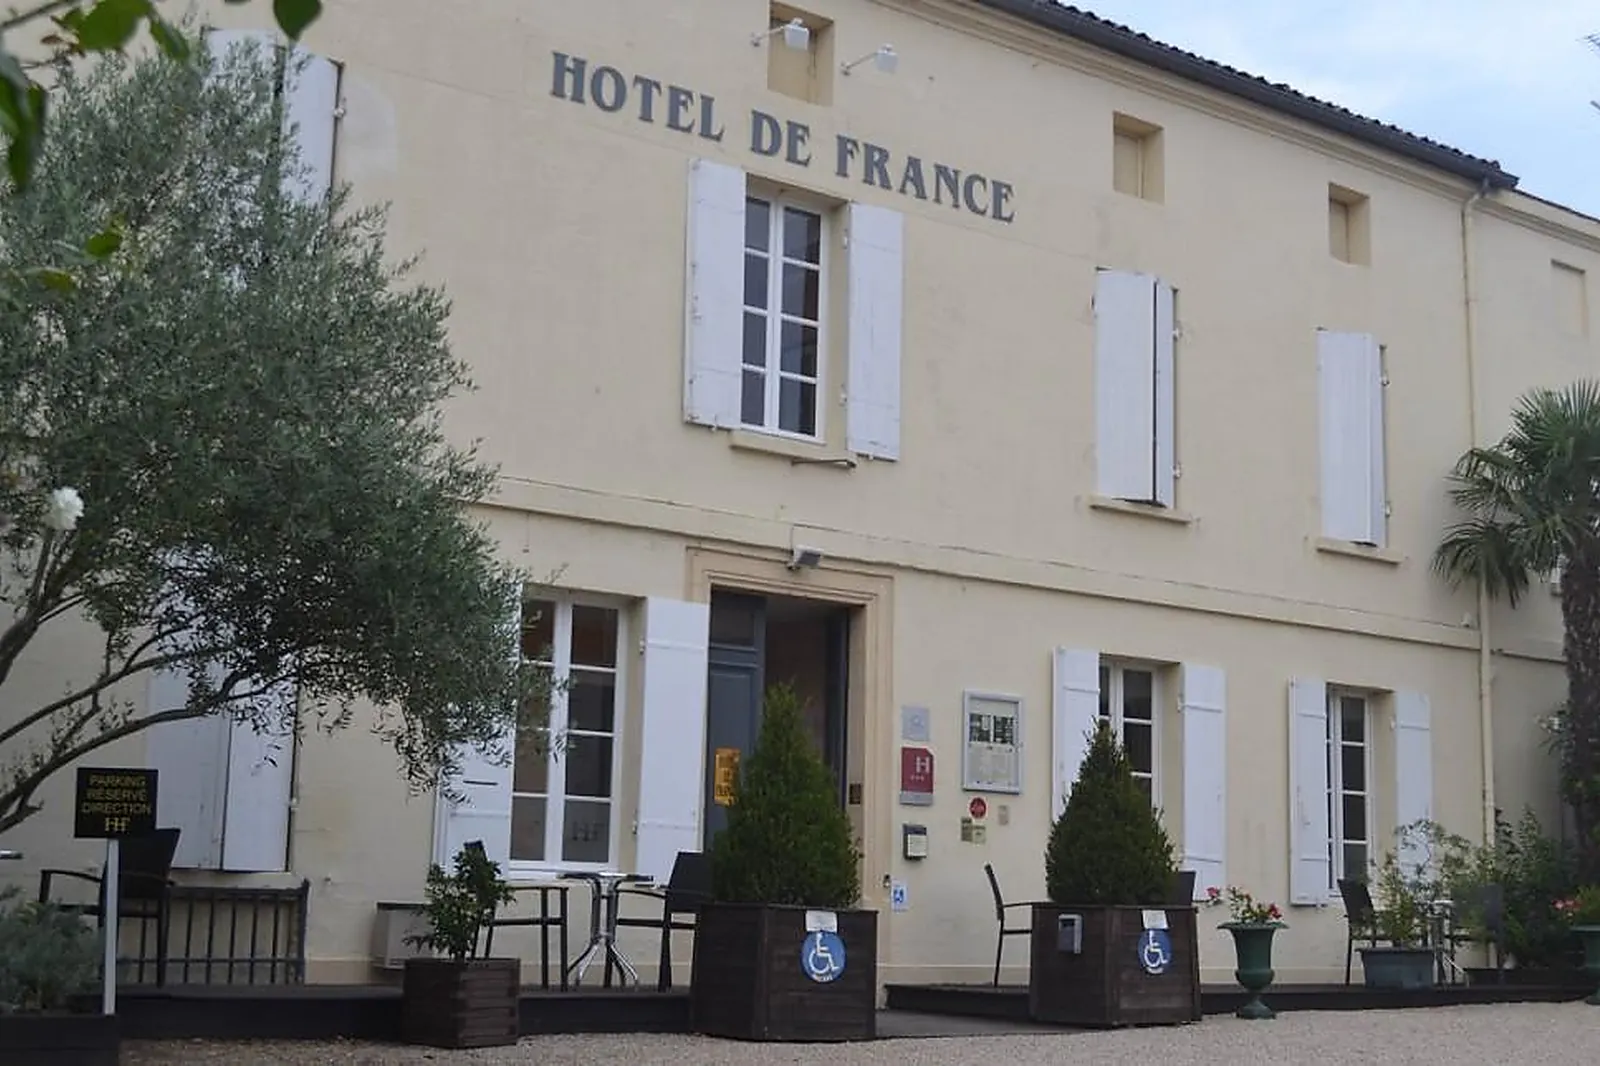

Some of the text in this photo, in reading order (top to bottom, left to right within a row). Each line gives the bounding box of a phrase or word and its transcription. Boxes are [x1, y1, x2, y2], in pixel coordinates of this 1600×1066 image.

[551, 51, 1015, 224] HOTEL DE FRANCE
[915, 755, 931, 774] H
[89, 774, 147, 787] PARKING
[81, 802, 152, 815] DIRECTION
